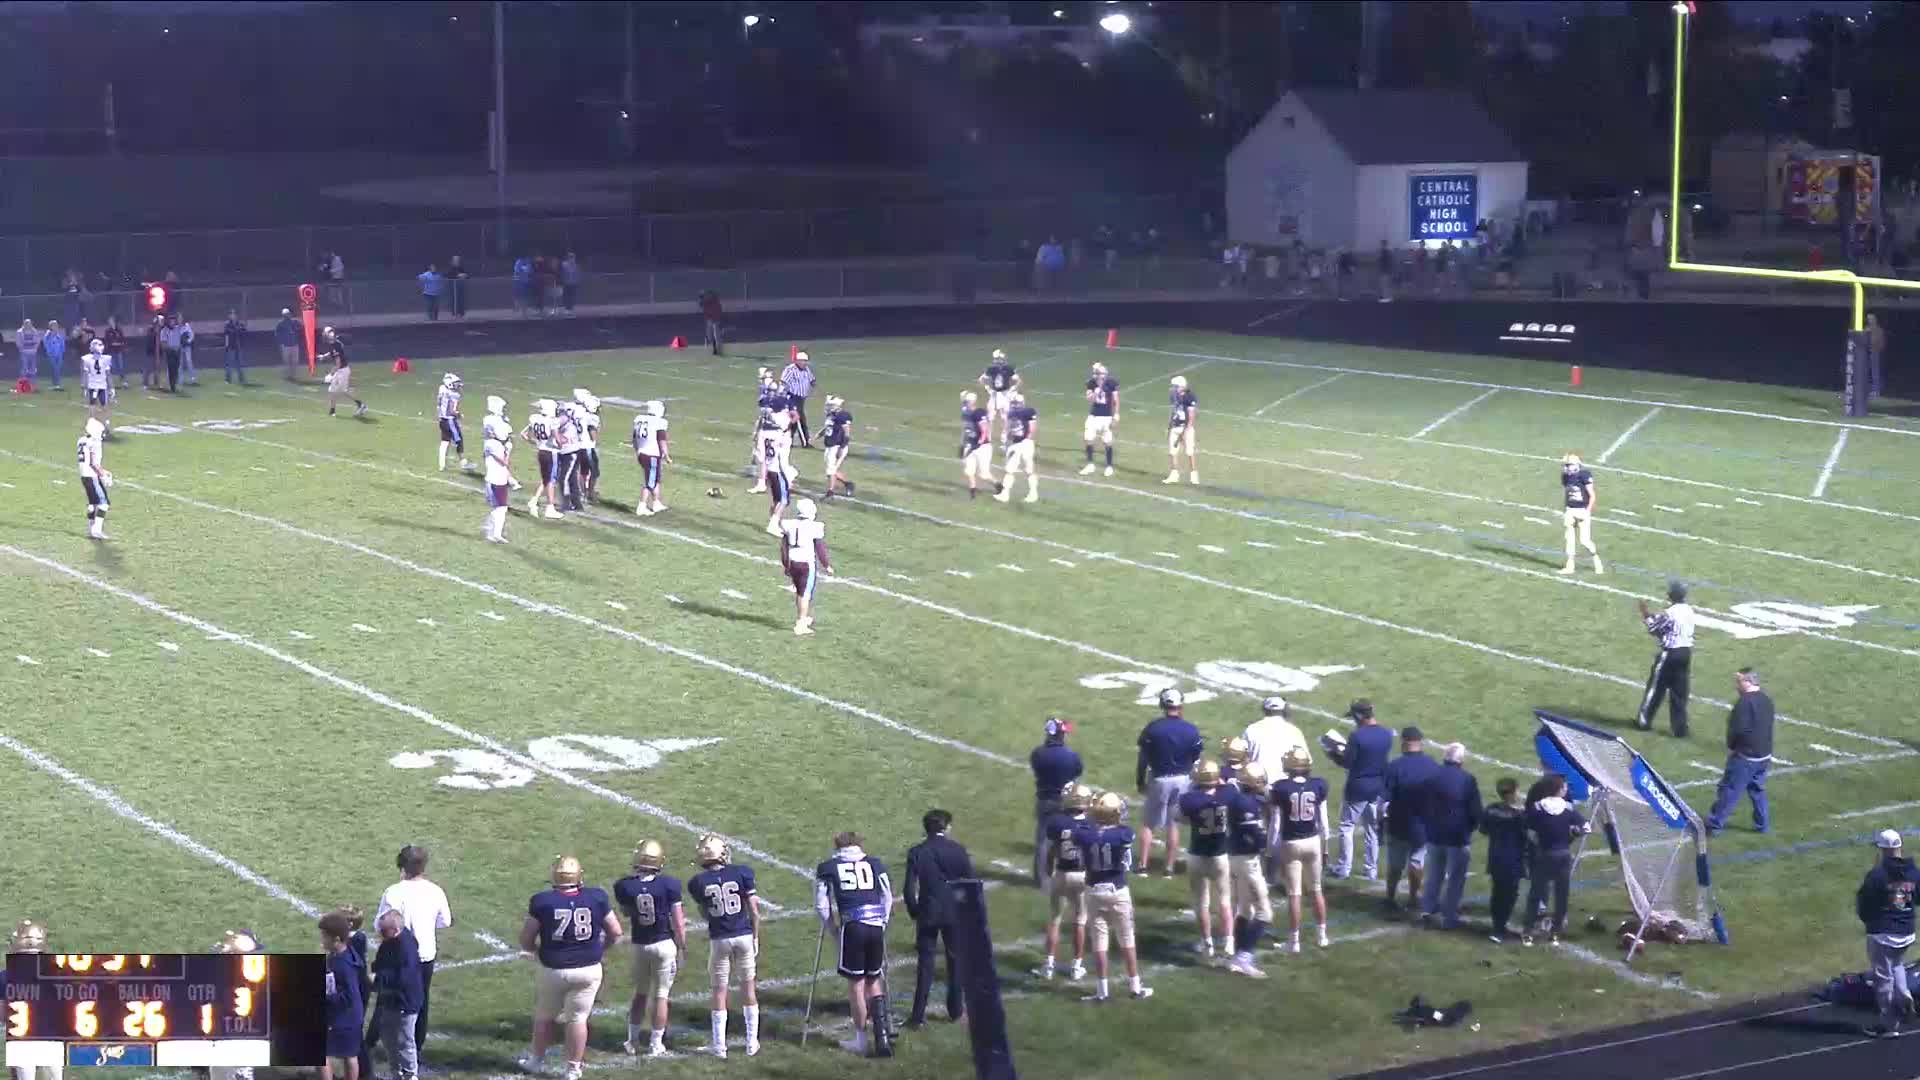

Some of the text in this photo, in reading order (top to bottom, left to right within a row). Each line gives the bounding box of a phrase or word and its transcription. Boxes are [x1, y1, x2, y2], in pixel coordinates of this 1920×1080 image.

[1420, 181, 1470, 192] CENTRAL
[1416, 194, 1471, 206] CATHOLIC
[1430, 208, 1458, 219] HIGH
[1420, 221, 1469, 233] SCHOOL
[93, 359, 102, 375] 4
[790, 526, 800, 548] 1
[1288, 791, 1316, 822] 16
[837, 861, 874, 890] 50
[636, 893, 656, 927] 9
[704, 881, 742, 918] 36
[552, 907, 593, 942] 78
